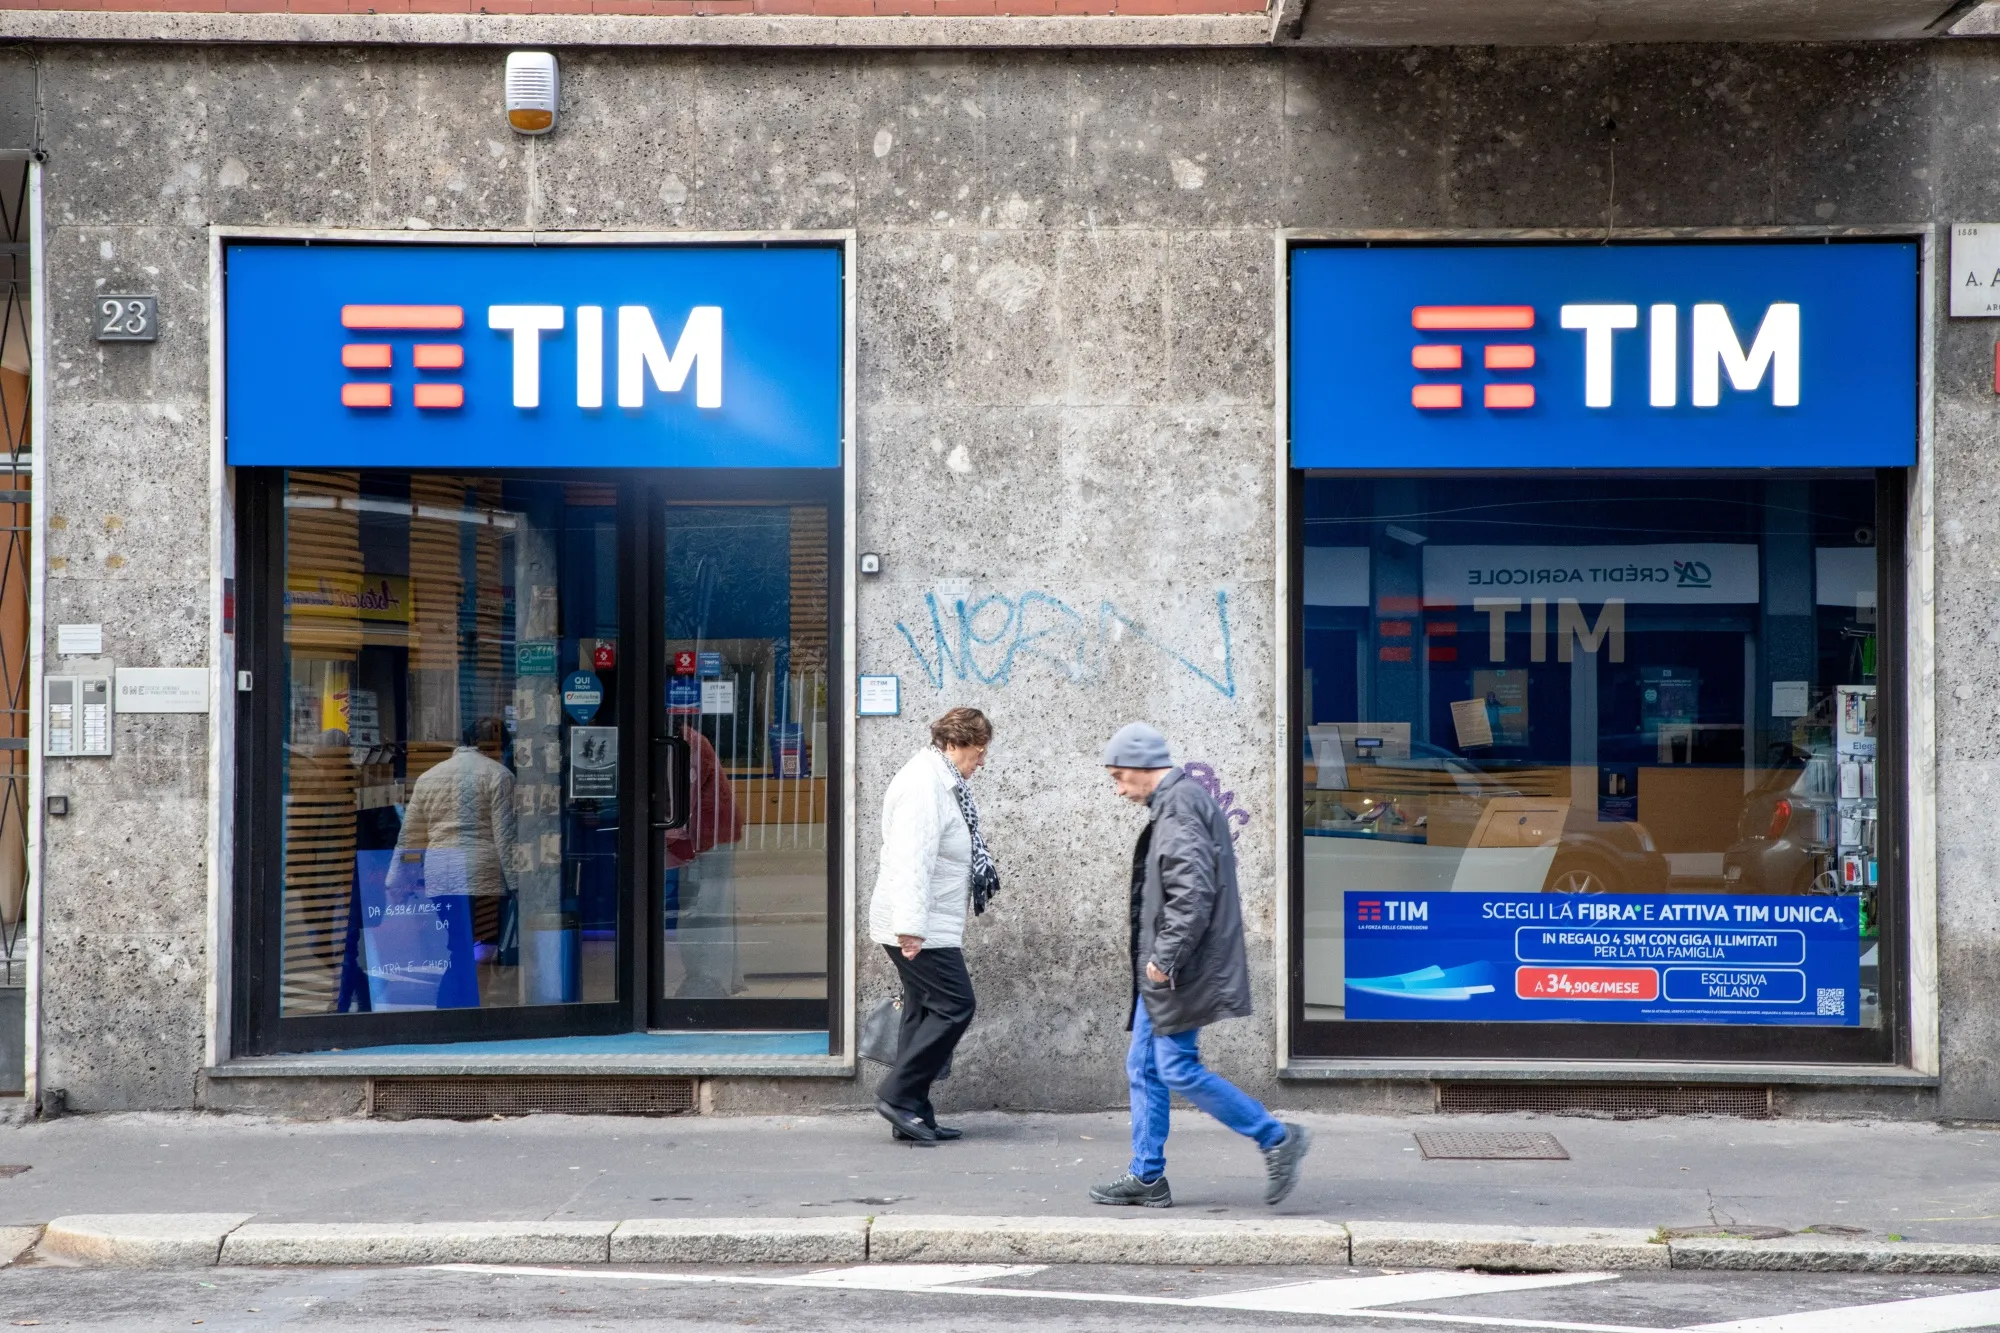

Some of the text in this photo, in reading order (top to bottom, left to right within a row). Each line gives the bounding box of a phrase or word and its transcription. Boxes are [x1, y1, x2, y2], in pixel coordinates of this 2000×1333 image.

[102, 299, 147, 335] 23
[487, 305, 723, 408] TIM
[1560, 303, 1800, 408] TIM
[1473, 597, 1625, 663] TIM
[574, 677, 591, 685] QUI
[368, 906, 380, 918] DA
[1384, 901, 1428, 921] TIM
[1482, 902, 1544, 920] SCEGLI
[1549, 903, 1573, 920] LA
[1644, 904, 1654, 921] E
[1659, 904, 1729, 921] ATTIVA
[1733, 905, 1769, 922] TIM
[1774, 906, 1844, 923] UNICA.
[436, 919, 449, 931] DA
[1543, 933, 1778, 947] IN REGALO 4 SIM CON GIGA ILLIMITATI
[1594, 946, 1725, 958] PER LA TUA FAMIGLIA
[1534, 973, 1640, 996] A 34,90€/MESE
[1701, 973, 1768, 986] ESCLUSIVA
[1708, 986, 1760, 998] MILANO
